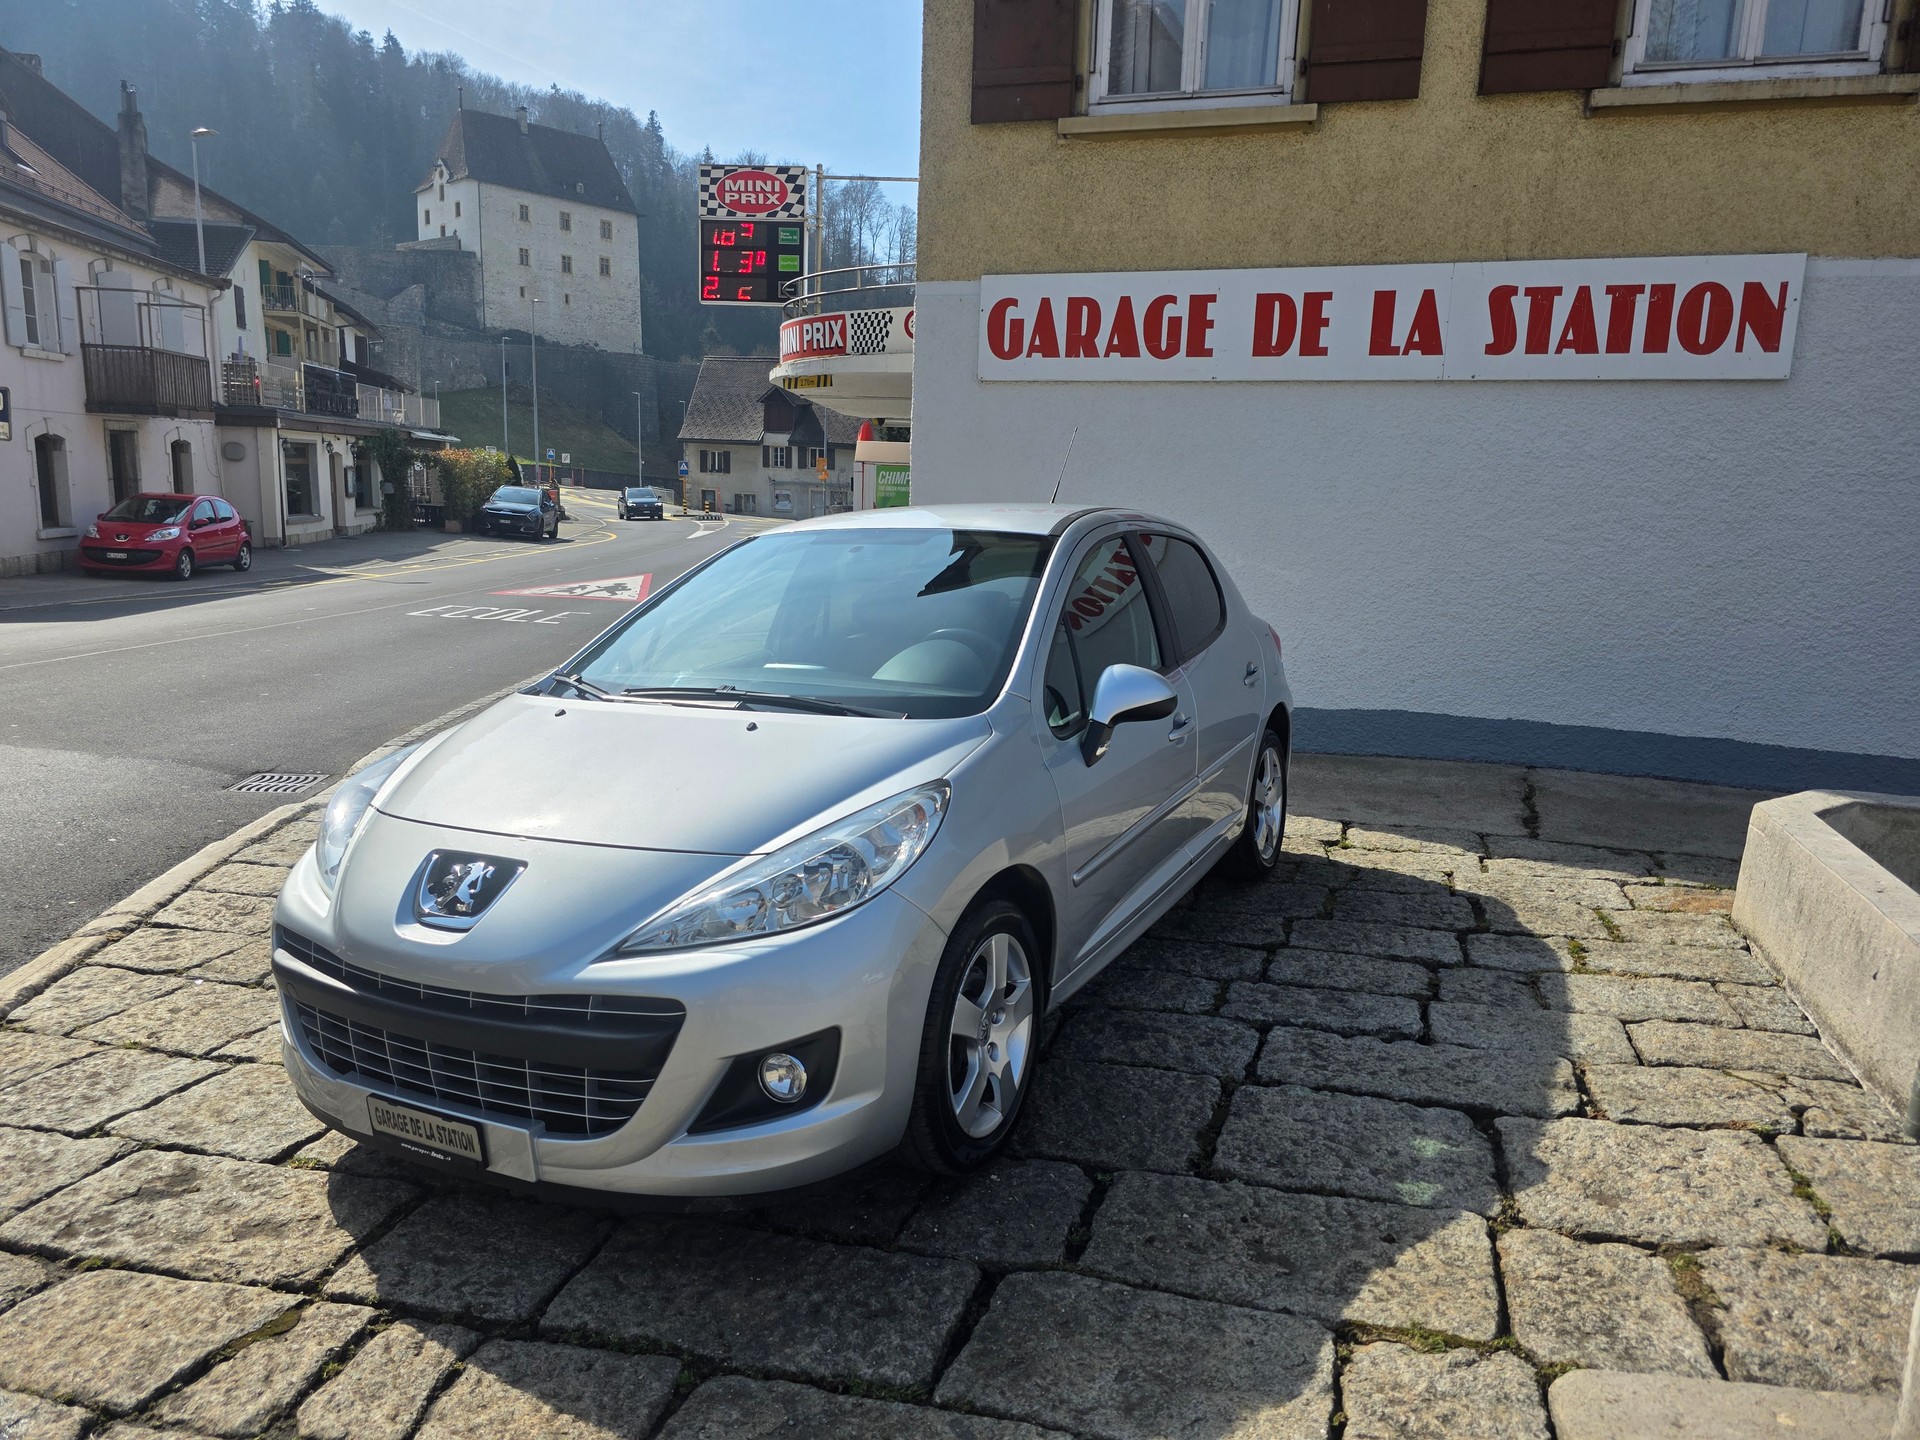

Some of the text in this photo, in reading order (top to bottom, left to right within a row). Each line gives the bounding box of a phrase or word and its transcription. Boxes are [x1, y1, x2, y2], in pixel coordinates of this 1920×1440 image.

[724, 180, 781, 193] MINI
[724, 193, 781, 205] PRIX
[986, 281, 1789, 360] GARAGE DE LA STATION
[782, 320, 844, 355] MINI PRIX
[405, 604, 592, 625] ECOLE
[375, 1107, 410, 1134] GARAGE
[409, 1117, 423, 1138] DE
[423, 1121, 436, 1142] LA
[436, 1125, 475, 1153] STATION
